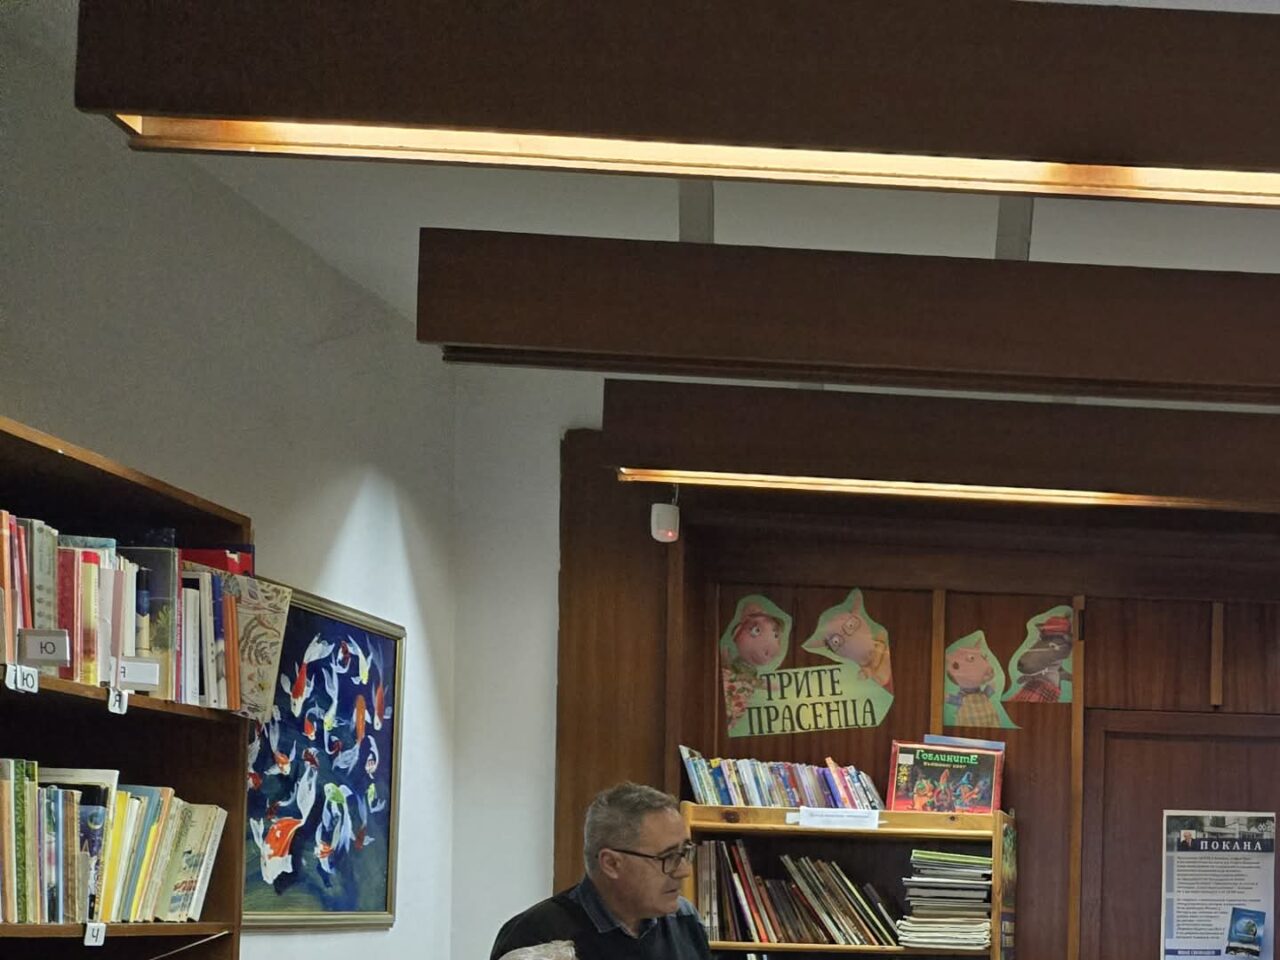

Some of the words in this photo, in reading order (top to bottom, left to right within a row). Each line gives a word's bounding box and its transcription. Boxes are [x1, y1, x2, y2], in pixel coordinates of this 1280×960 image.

[760, 668, 843, 701] ТРИТЕ
[746, 698, 877, 735] ПРАСЕНЦА
[1200, 840, 1262, 851] ПОКАНА
